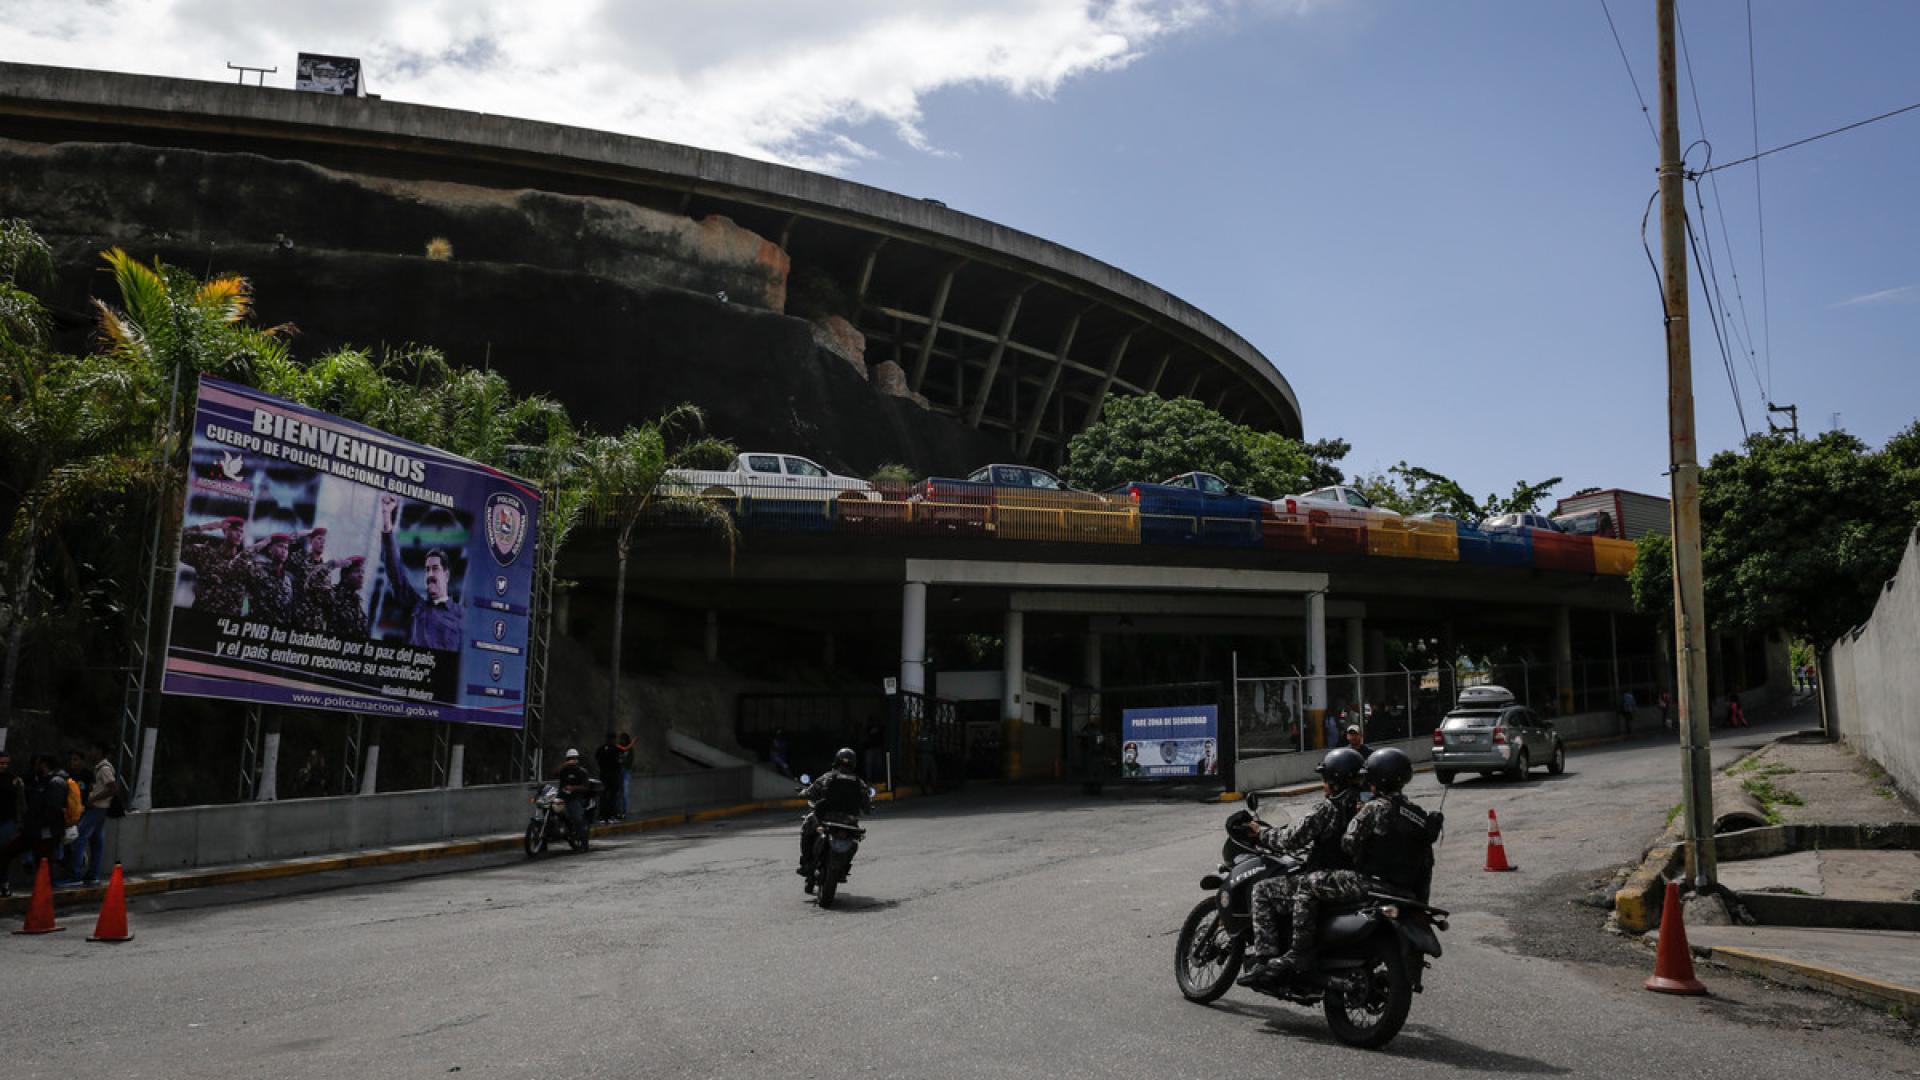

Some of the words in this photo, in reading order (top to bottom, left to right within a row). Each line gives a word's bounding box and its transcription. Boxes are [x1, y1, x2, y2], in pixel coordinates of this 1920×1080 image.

[253, 408, 425, 482] BIENVENIDOS
[207, 424, 260, 452] CUERPO
[263, 440, 280, 457] DE
[331, 461, 386, 488] NACIONAL
[388, 478, 454, 508] BOLIVARIANA
[215, 641, 226, 657] y
[227, 640, 241, 656] el
[271, 648, 310, 665] entero
[310, 654, 361, 673] reconoce
[362, 663, 377, 675] su
[241, 622, 270, 640] PNB
[271, 627, 287, 643] ha
[288, 630, 341, 651] batallado
[342, 641, 363, 656] por
[363, 642, 374, 657] la
[374, 647, 396, 661] paz
[396, 648, 413, 662] del
[293, 693, 440, 717] www.policianacional.gob.ve
